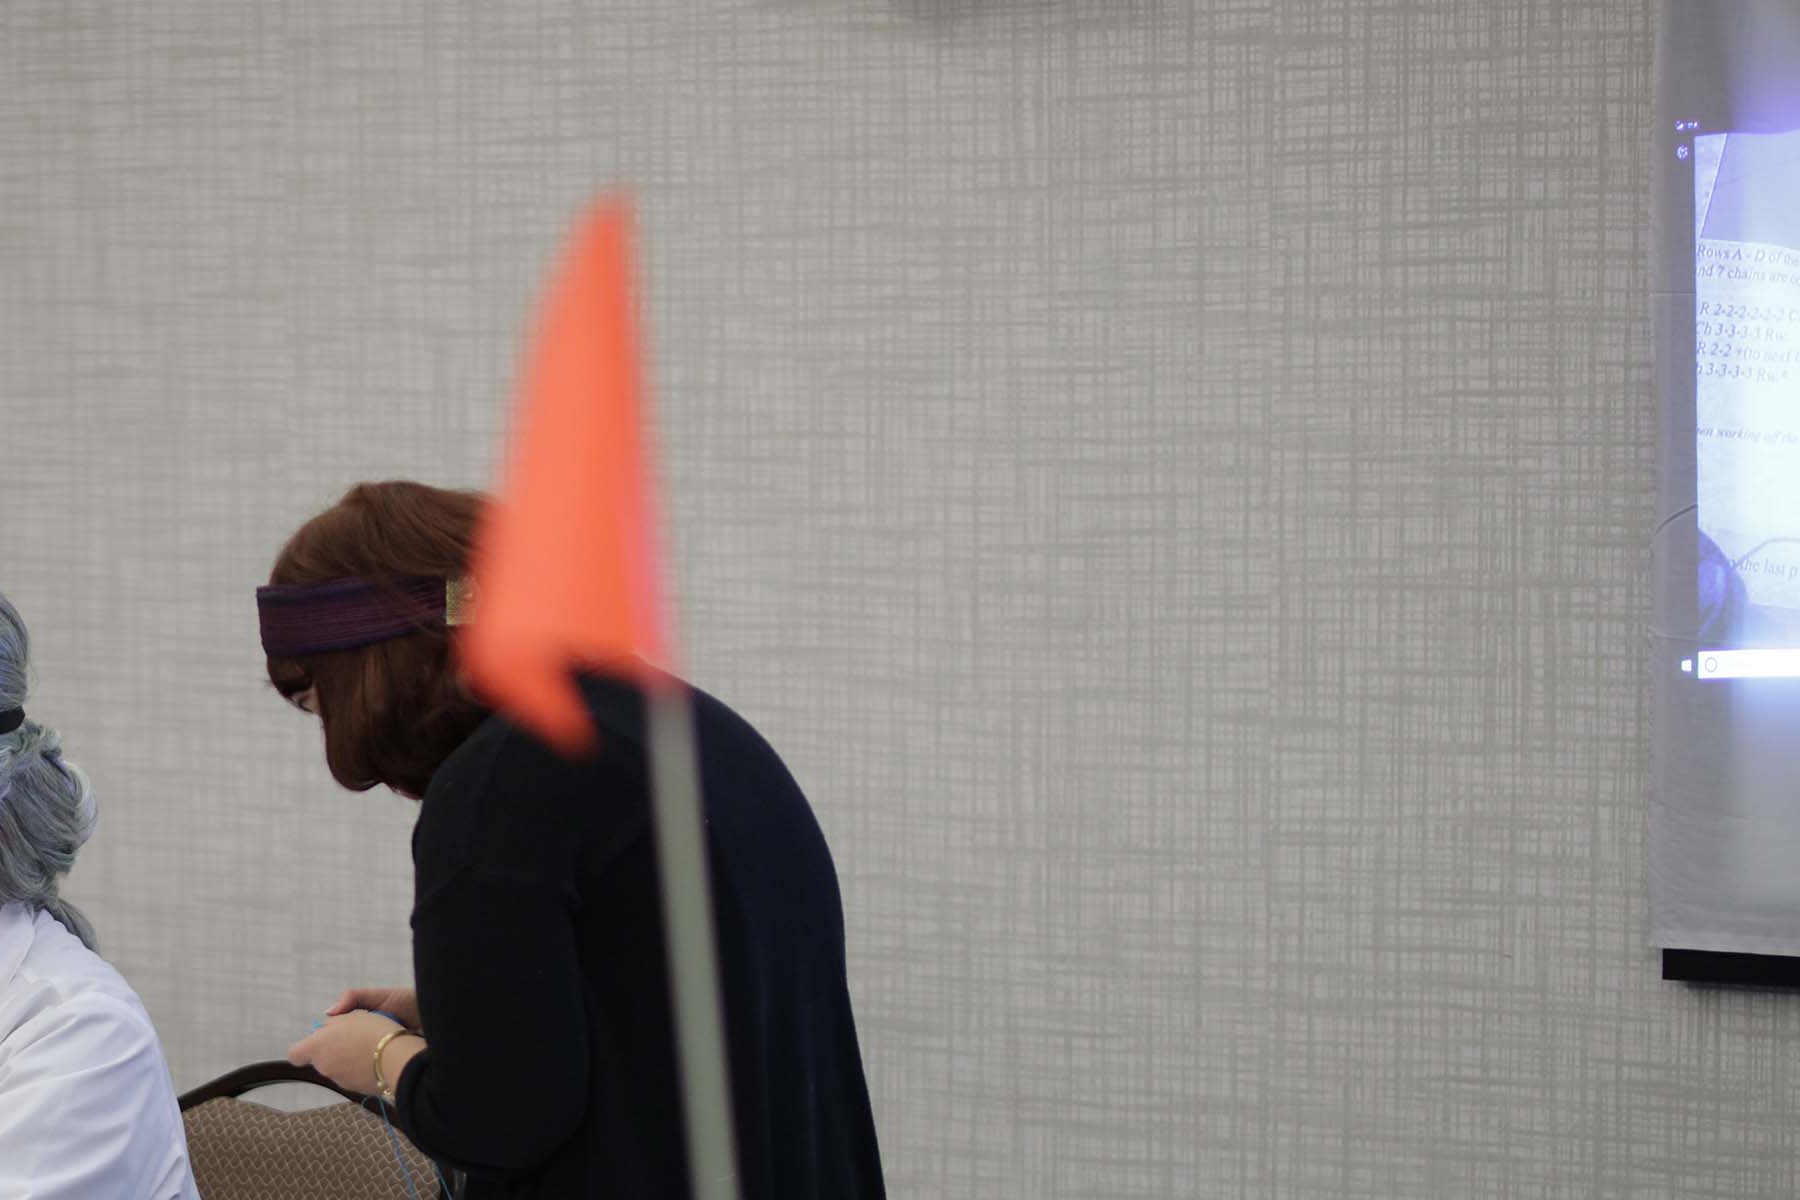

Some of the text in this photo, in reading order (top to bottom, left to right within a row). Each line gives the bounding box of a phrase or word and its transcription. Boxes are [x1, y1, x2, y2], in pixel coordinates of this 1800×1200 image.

[1697, 244, 1729, 260] Rows
[1732, 248, 1742, 261] A
[1754, 248, 1765, 262] D
[1697, 264, 1714, 277] nd
[1727, 266, 1766, 281] chains
[1699, 302, 1710, 315] R
[1716, 427, 1761, 444] working
[1763, 557, 1786, 577] last
